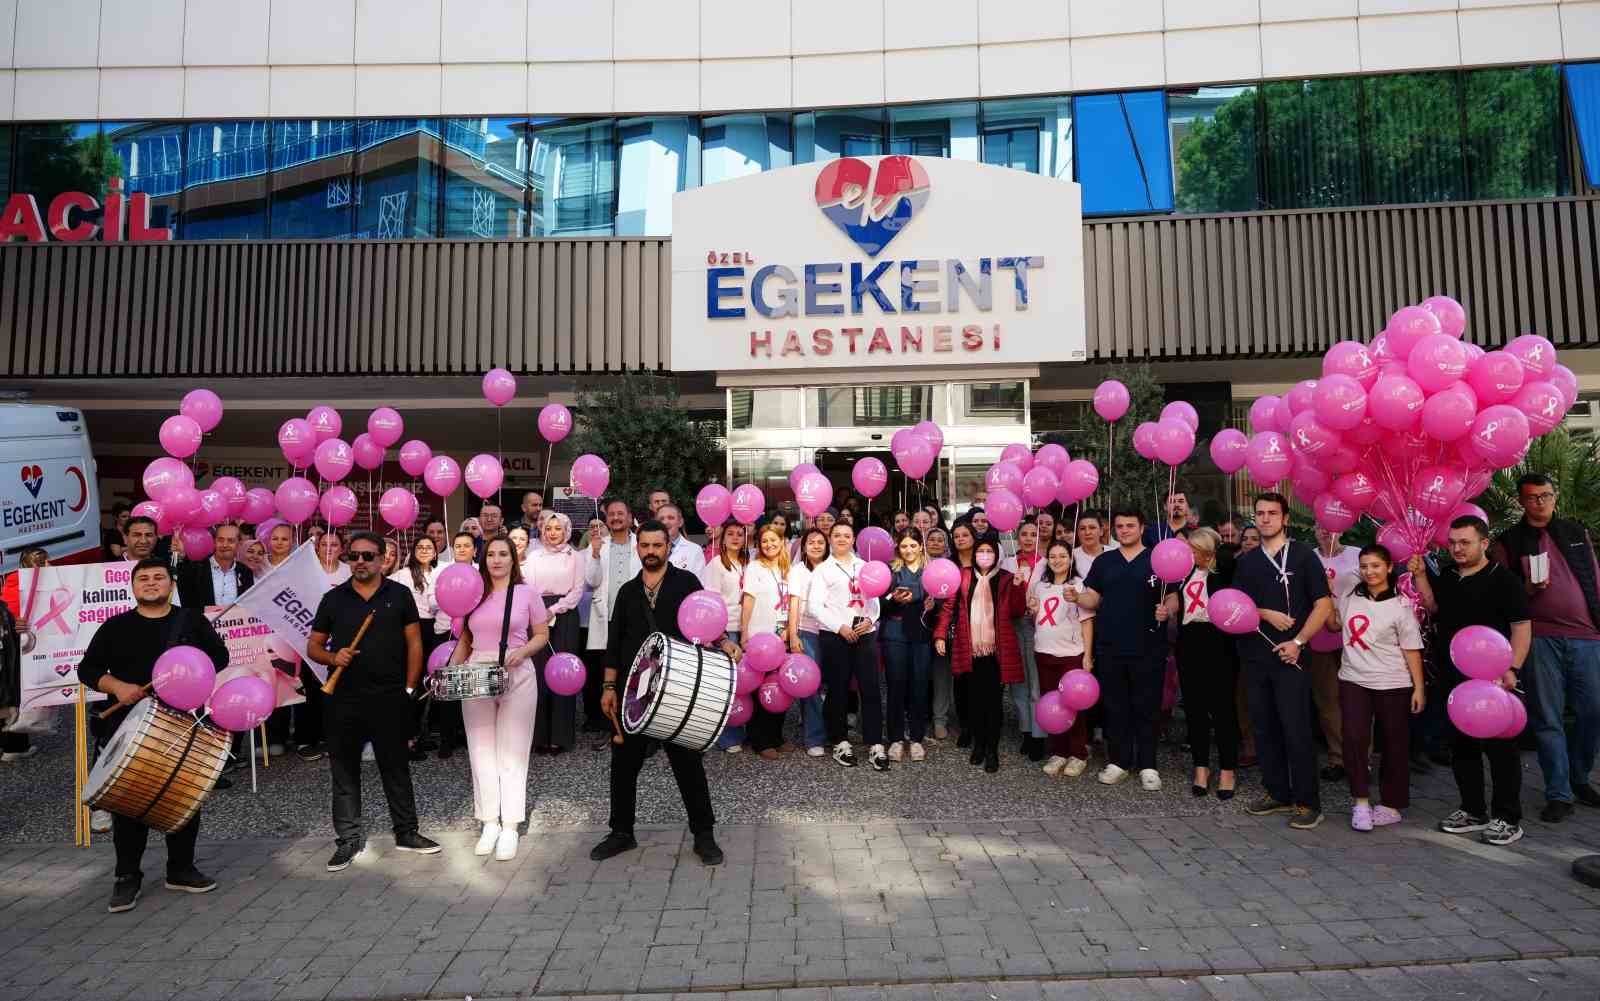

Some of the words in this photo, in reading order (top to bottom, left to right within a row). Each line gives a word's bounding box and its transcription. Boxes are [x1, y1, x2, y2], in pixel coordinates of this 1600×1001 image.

[0, 176, 172, 241] ACİL
[707, 251, 754, 265] ÖZEL
[707, 256, 1044, 319] EGEKENT
[750, 323, 1001, 358] HASTANESİ
[213, 466, 285, 477] EGEKENT
[3, 499, 65, 527] EGEKENT
[105, 569, 130, 585] Geç
[282, 614, 309, 638] HASTA
